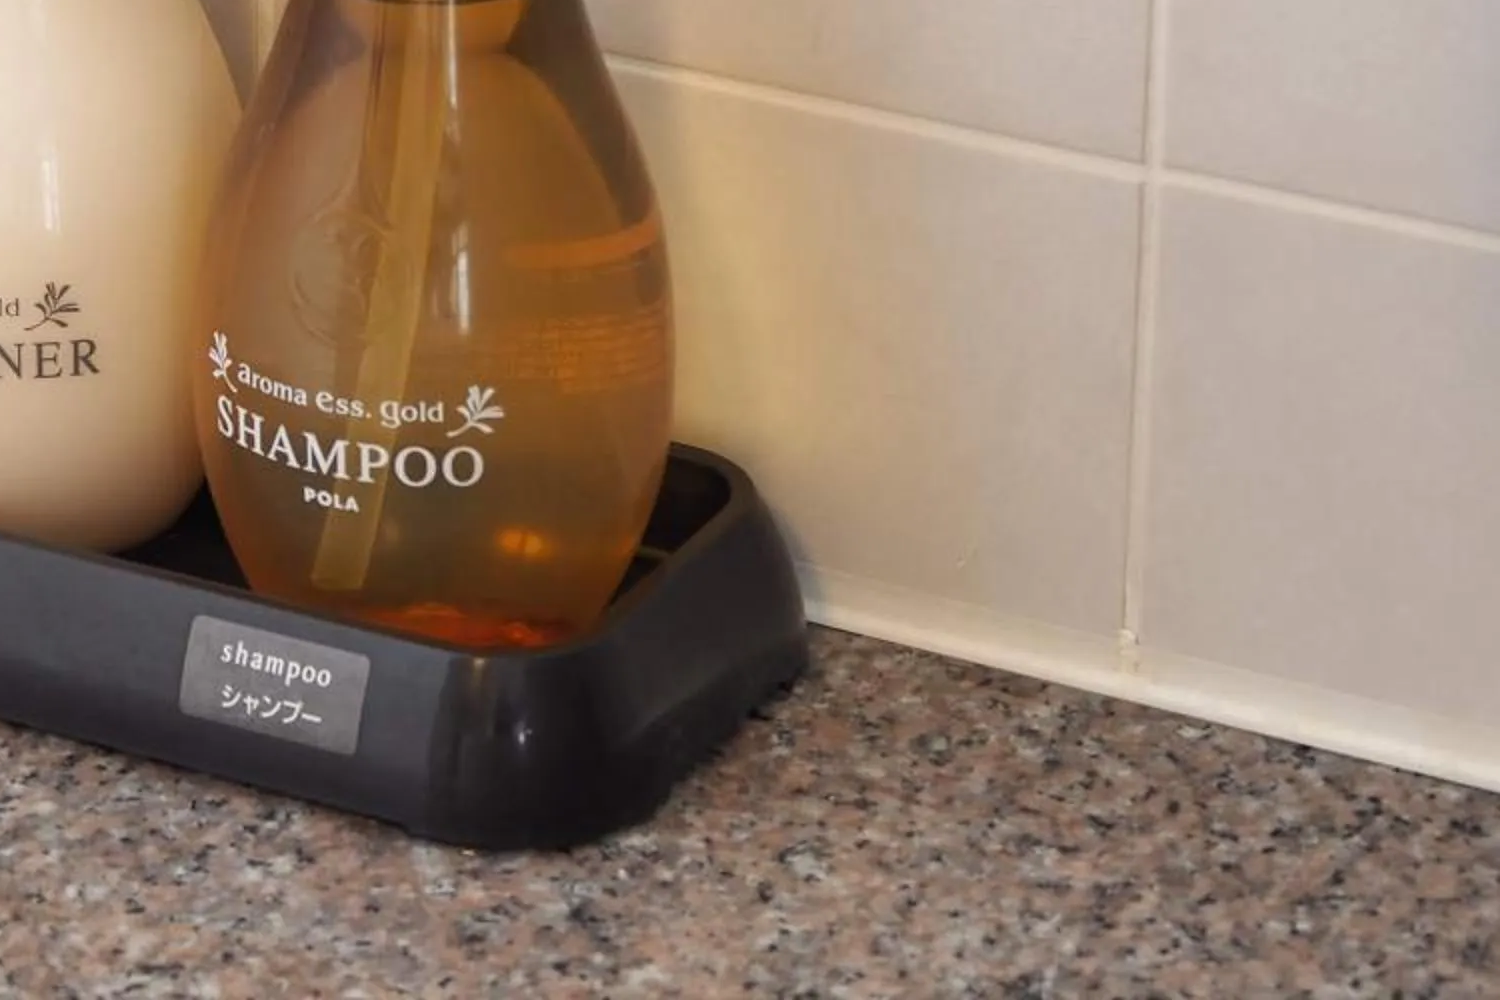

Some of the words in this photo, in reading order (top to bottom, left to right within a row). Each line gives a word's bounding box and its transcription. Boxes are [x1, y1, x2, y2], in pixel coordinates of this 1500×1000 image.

[237, 363, 307, 406] aroma
[315, 391, 372, 419] ess.
[380, 401, 444, 428] gold
[217, 395, 485, 487] SHAMPOO
[303, 486, 359, 513] POLA
[220, 640, 332, 687] shampoo
